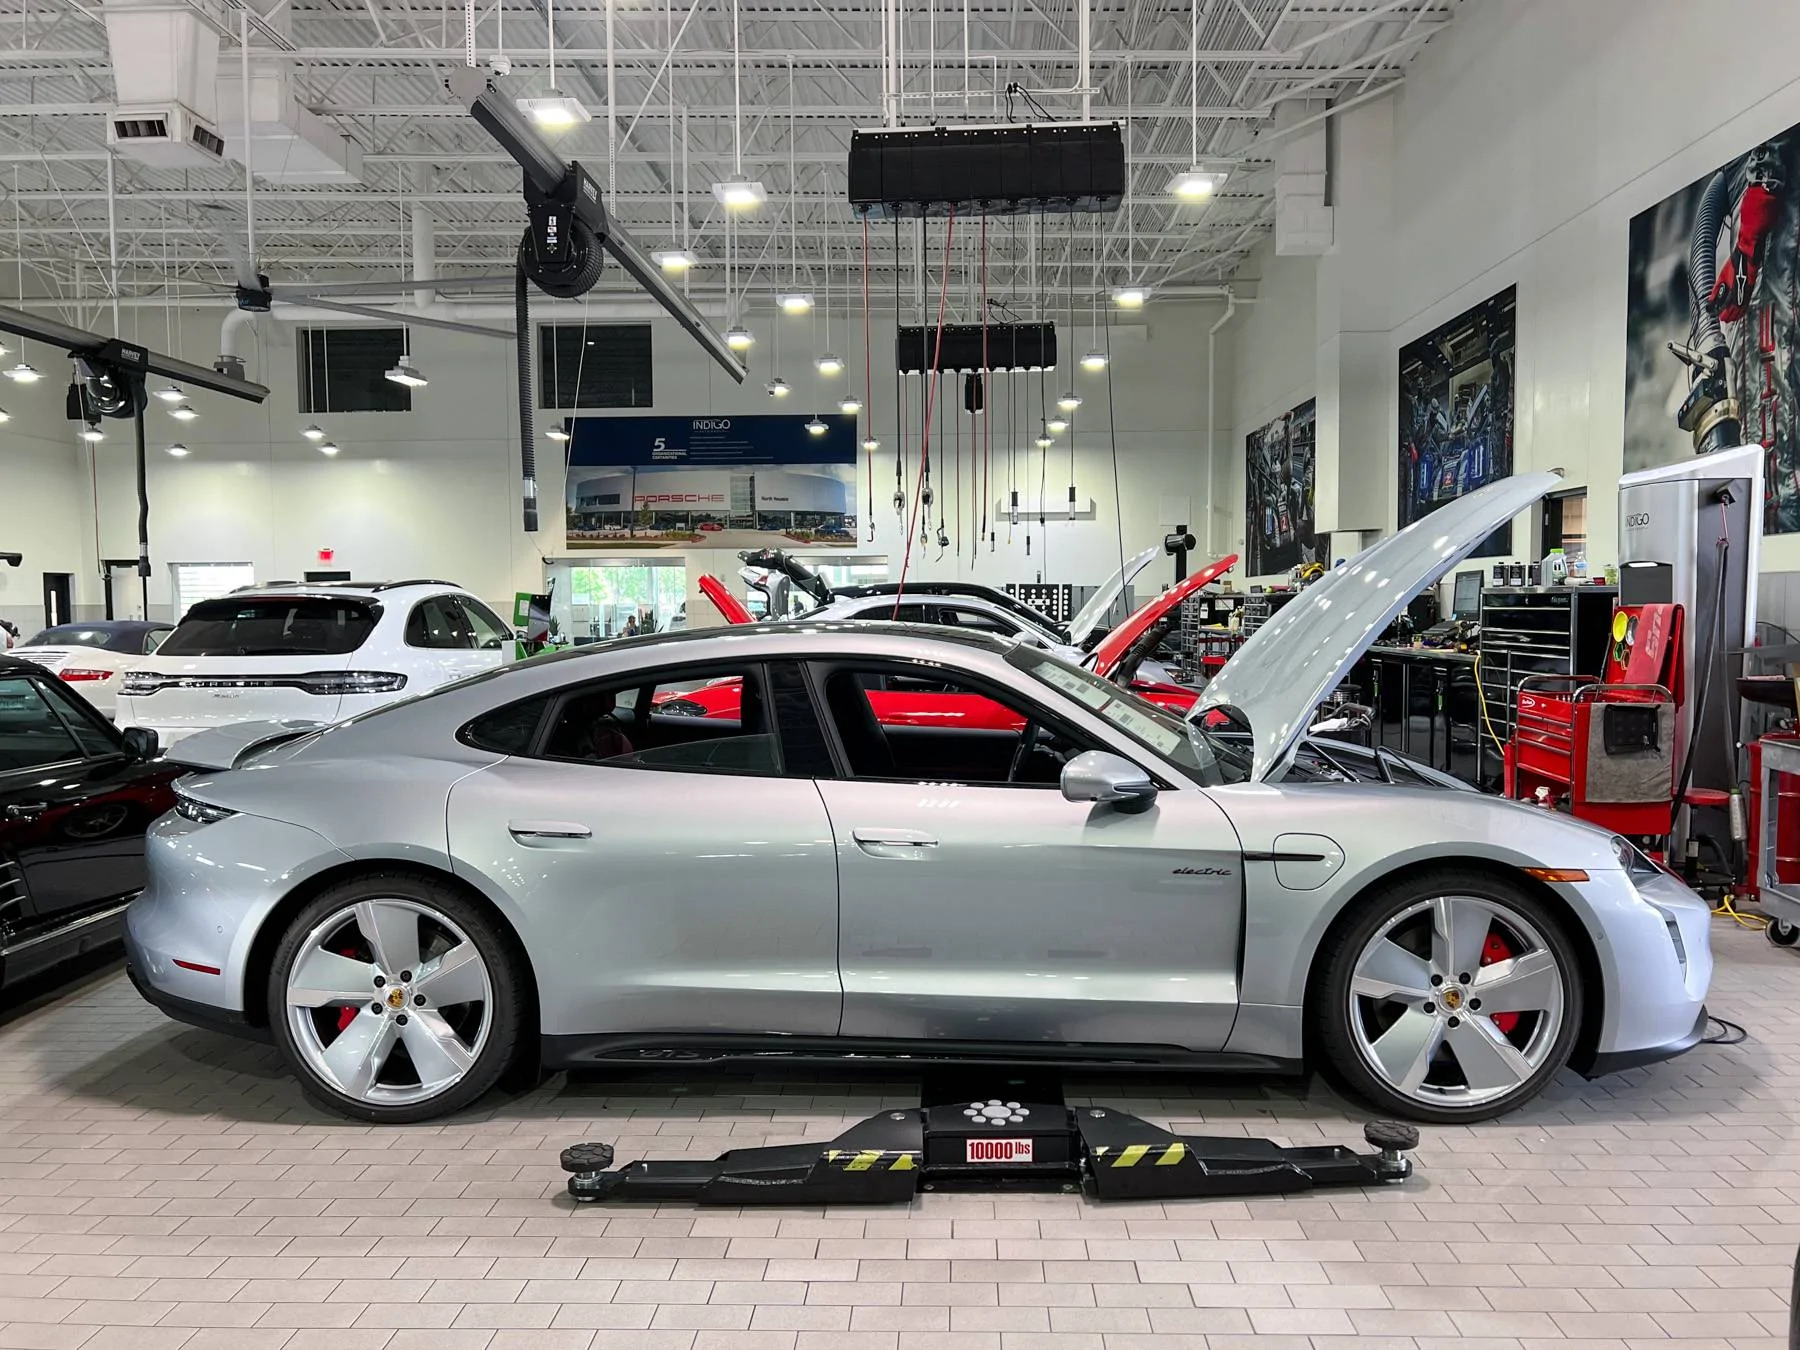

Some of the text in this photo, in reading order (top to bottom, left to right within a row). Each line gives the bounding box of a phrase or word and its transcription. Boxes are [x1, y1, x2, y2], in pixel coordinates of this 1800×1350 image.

[693, 419, 731, 430] INDIGO
[653, 438, 666, 451] 5
[634, 494, 725, 503] PORSCHE
[1172, 867, 1232, 876] electric
[969, 1142, 1031, 1160] 10000 lbs
